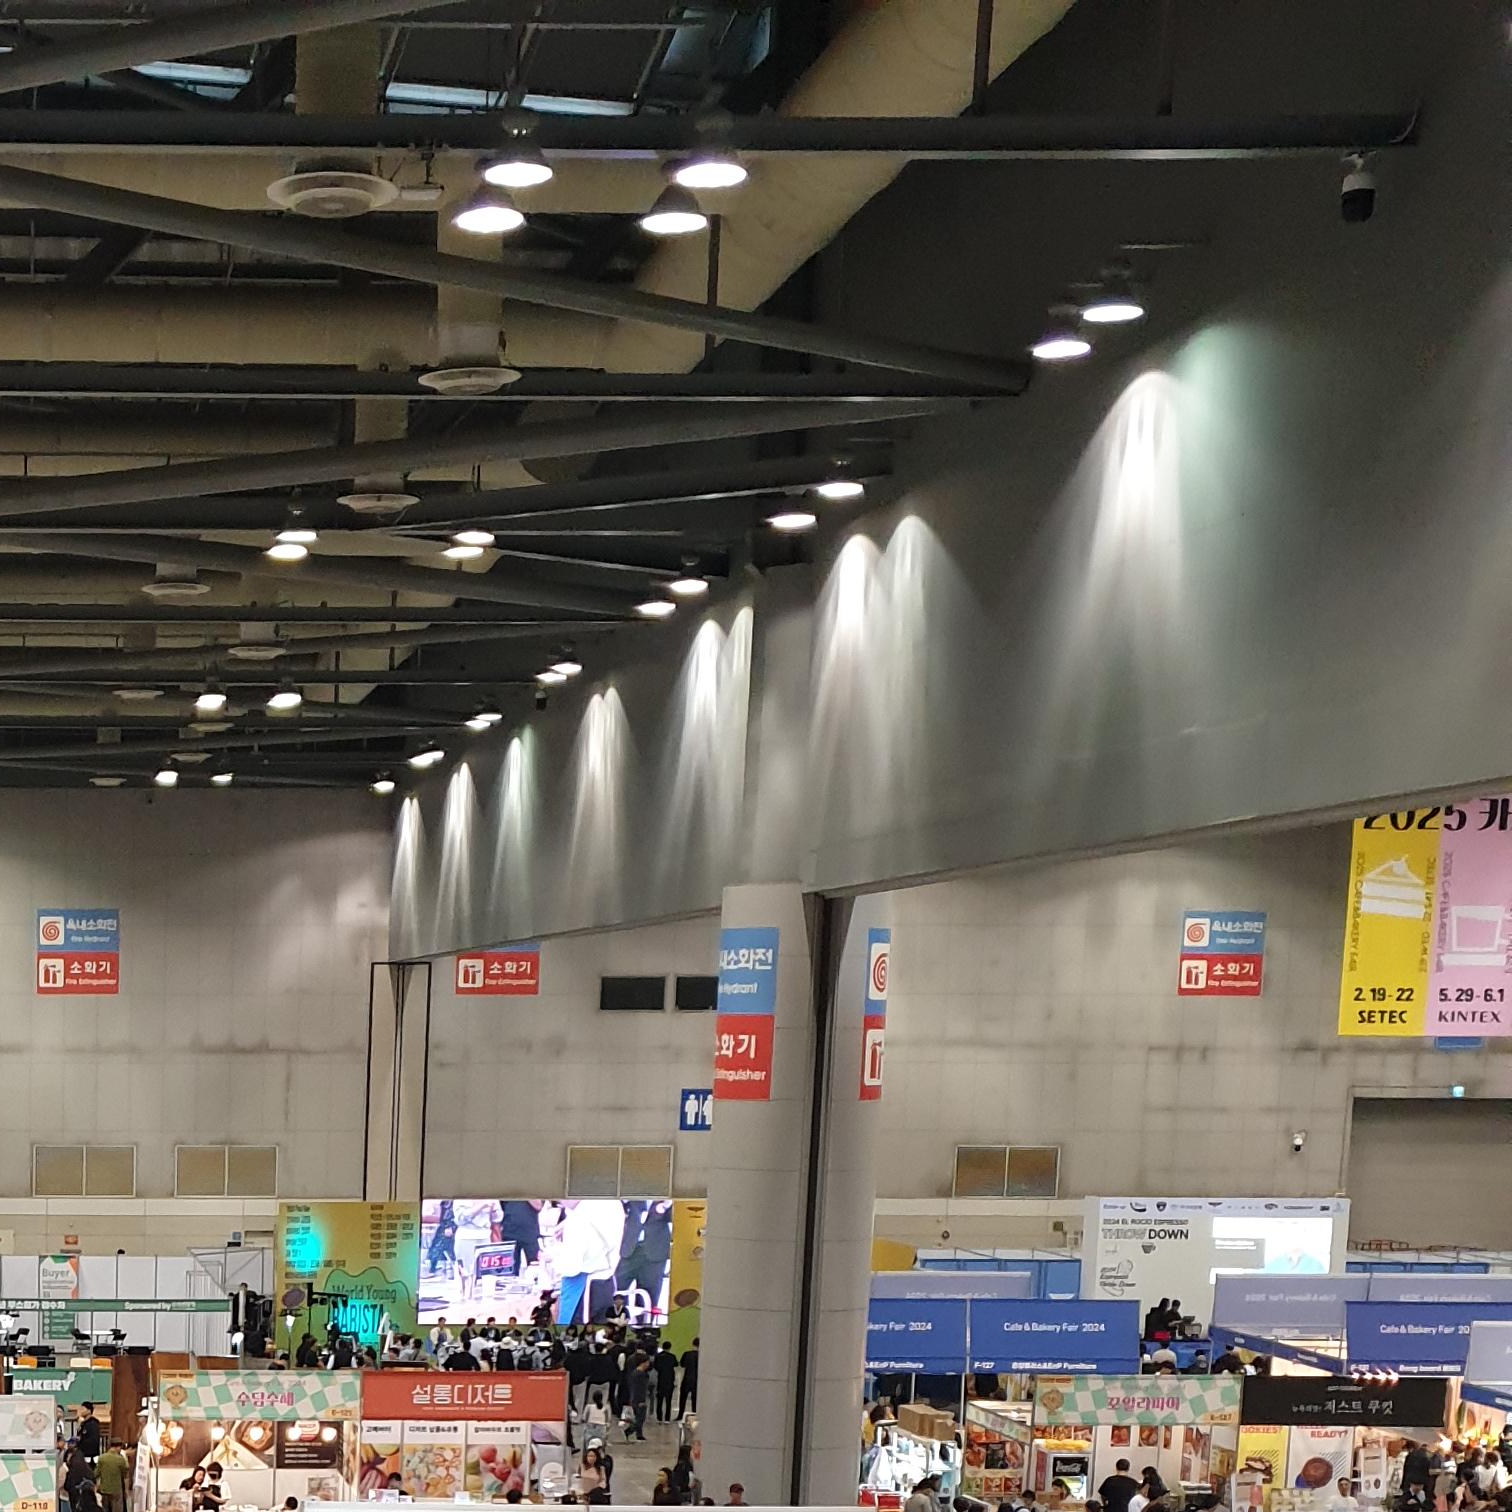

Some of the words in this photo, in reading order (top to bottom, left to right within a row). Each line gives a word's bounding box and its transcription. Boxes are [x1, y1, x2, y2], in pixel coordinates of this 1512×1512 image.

[488, 960, 532, 975] 소화기
[1213, 963, 1255, 976] 소화기
[1357, 1010, 1408, 1024] SETEC
[1438, 1011, 1502, 1024] KINTEX
[1148, 1229, 1189, 1240] DOWN
[42, 1269, 70, 1279] Buyer
[365, 1285, 397, 1303] Young
[13, 1380, 70, 1391] BAKERY
